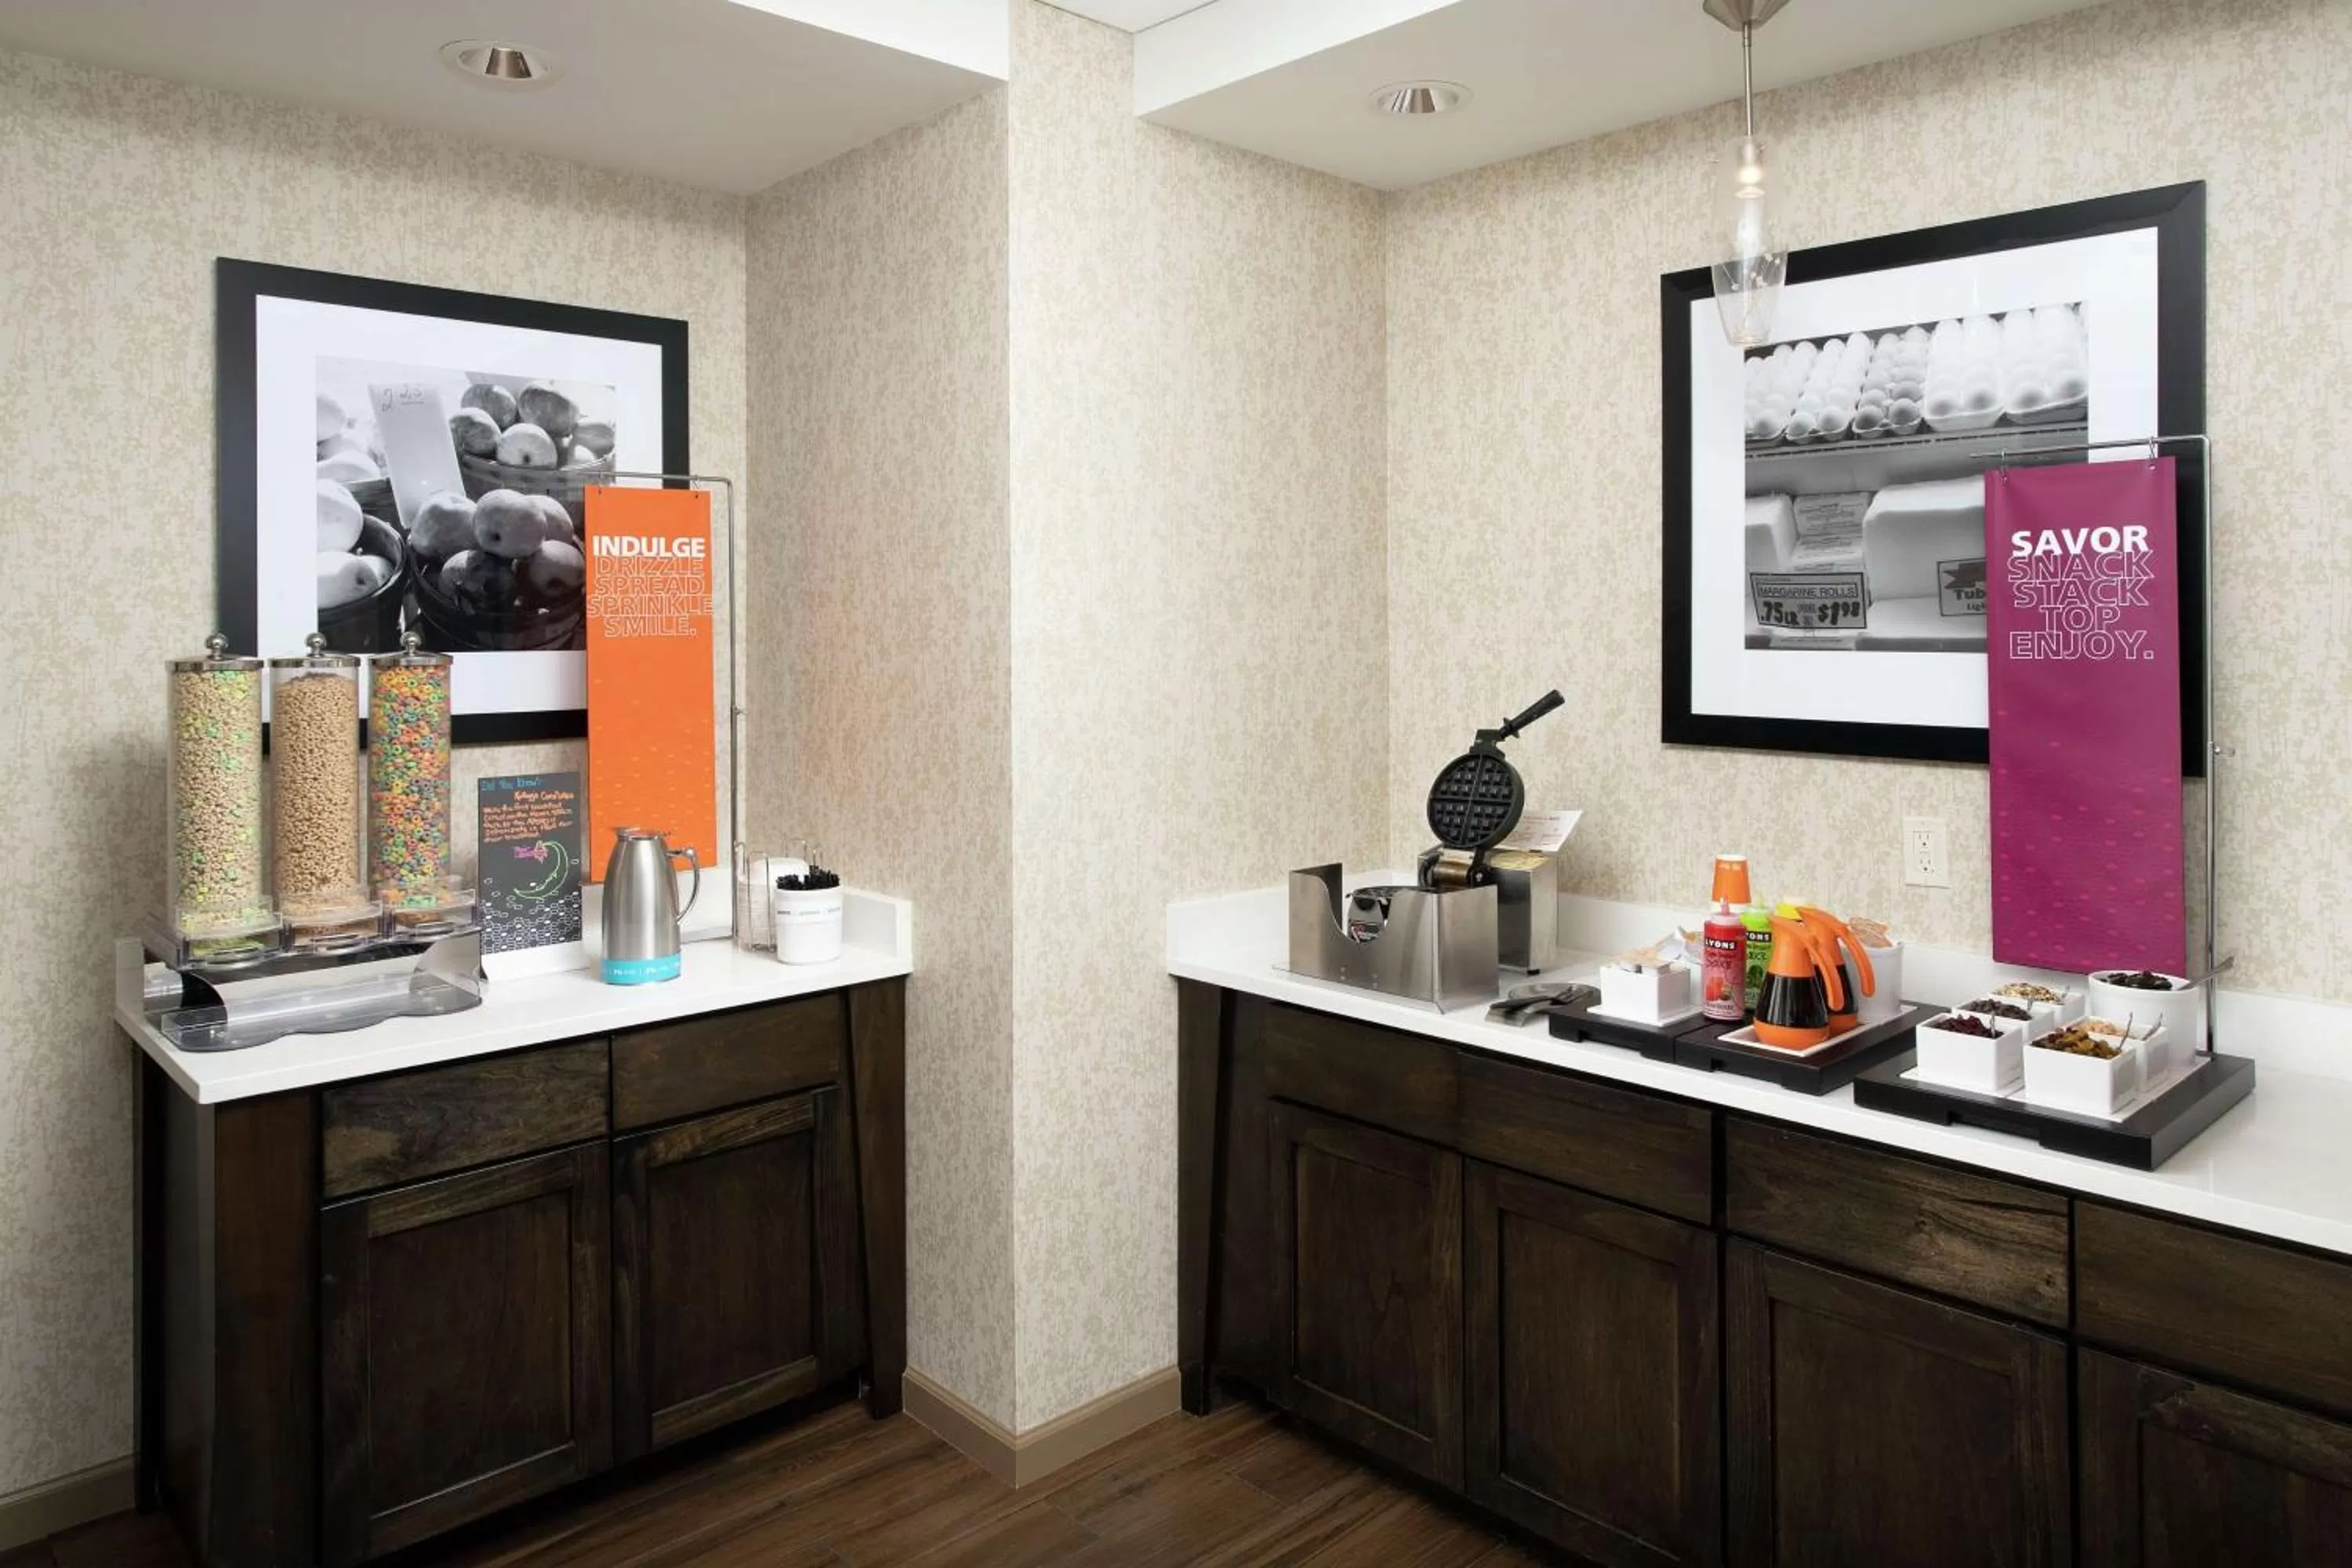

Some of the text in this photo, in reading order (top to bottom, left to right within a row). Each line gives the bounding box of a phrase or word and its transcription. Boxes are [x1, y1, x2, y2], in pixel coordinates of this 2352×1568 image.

[592, 535, 706, 558] INDULGE
[2011, 524, 2149, 557] SAVOR
[595, 555, 704, 577] DRIZZLE
[2007, 550, 2154, 583] SNACK
[595, 575, 705, 596] SPREAD
[2013, 577, 2149, 608] STACK
[586, 594, 715, 617] SPRINKLE
[604, 615, 697, 637] SMILE.
[2039, 604, 2121, 632] TOP
[2009, 630, 2154, 659] ENJOY.
[1705, 938, 1735, 949] LYONS
